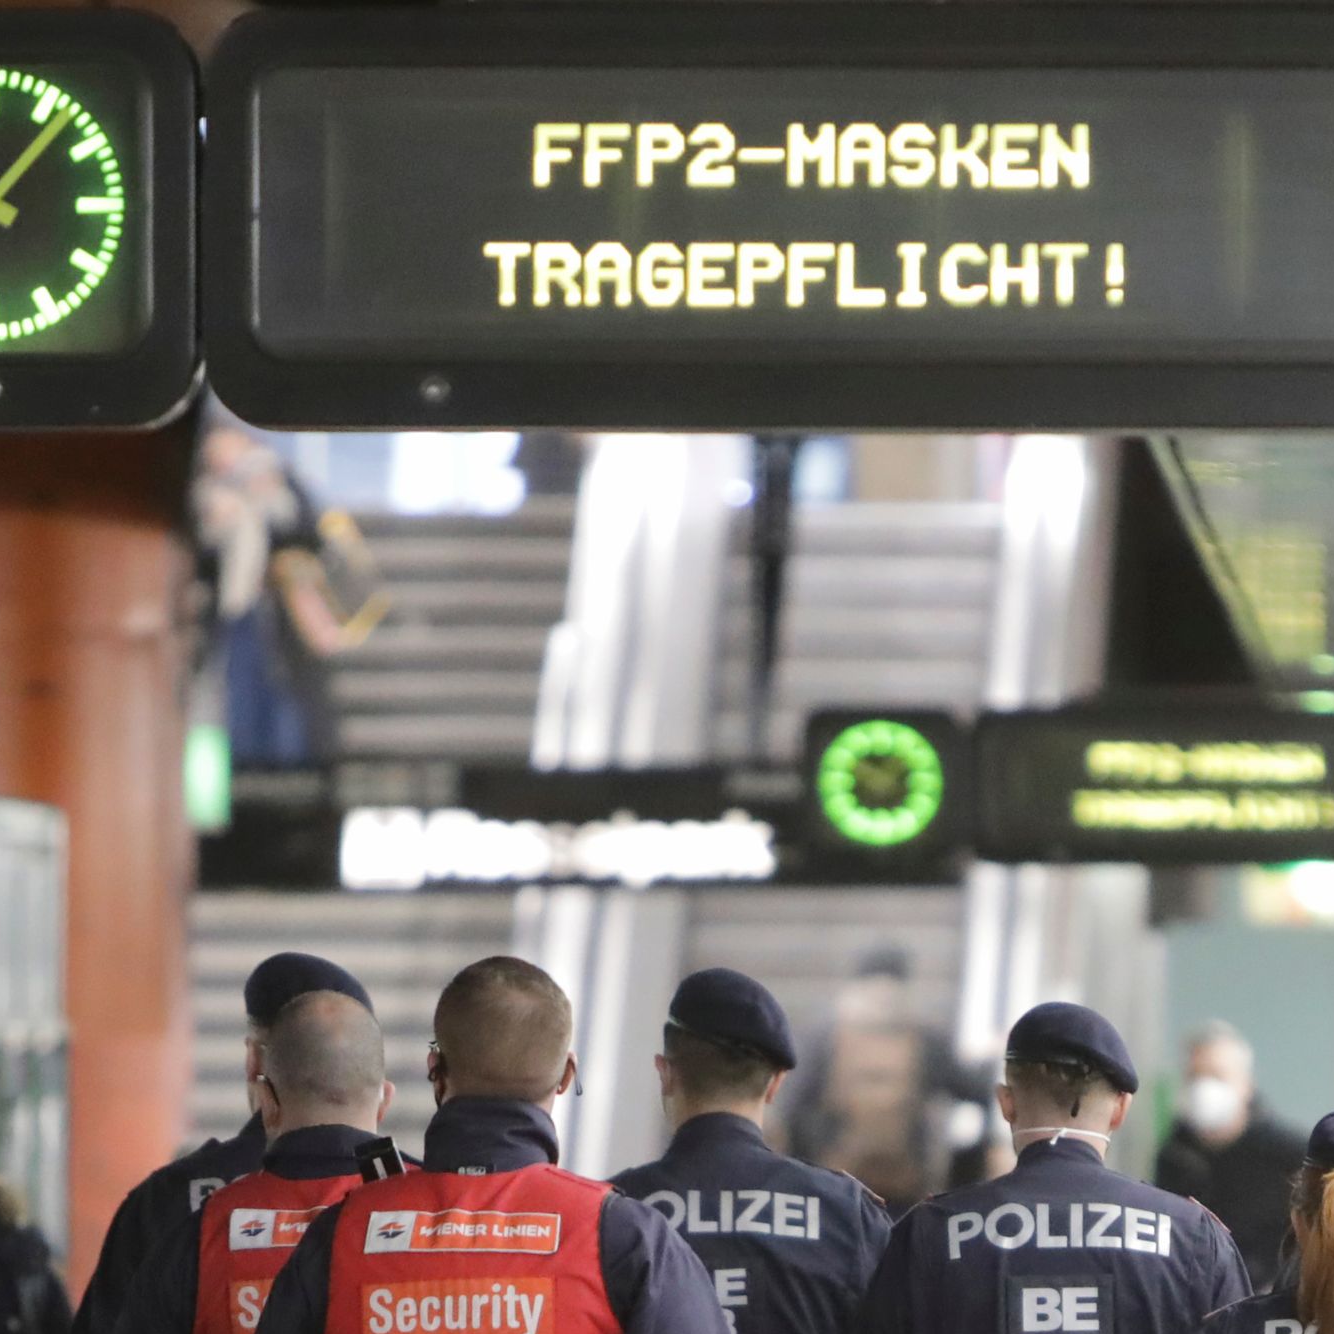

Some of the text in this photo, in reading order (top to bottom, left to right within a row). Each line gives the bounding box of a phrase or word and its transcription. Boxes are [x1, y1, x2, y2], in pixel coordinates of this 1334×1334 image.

[532, 122, 1091, 189] FFP2-MASKEN
[482, 241, 1126, 308] TRAGEPFLICHT!
[419, 1222, 551, 1238] WIENER LINIEN
[947, 1202, 1172, 1261] POLIZEI
[237, 1285, 268, 1329] S
[1022, 1286, 1100, 1333] BE
